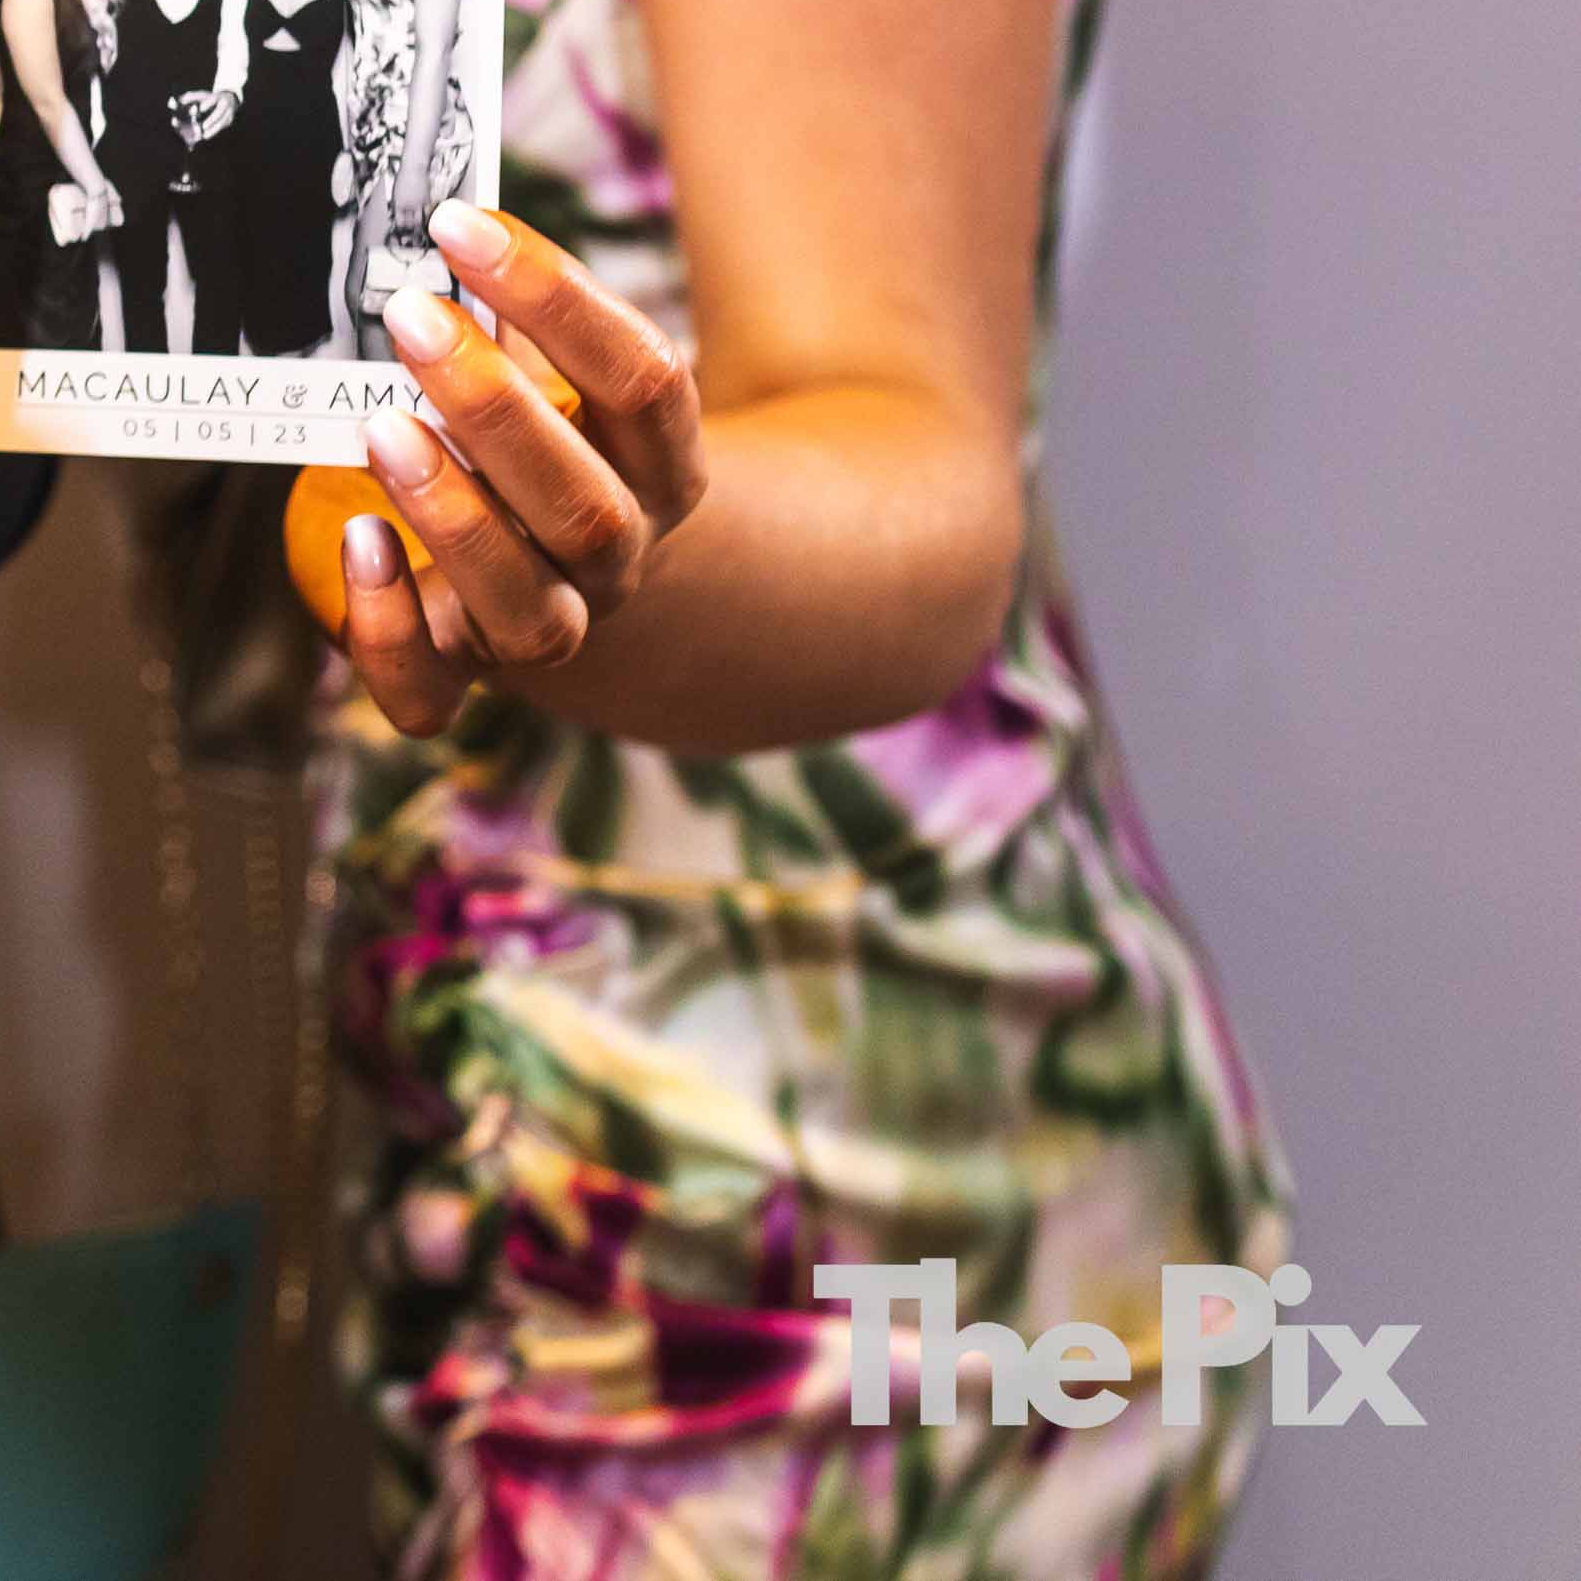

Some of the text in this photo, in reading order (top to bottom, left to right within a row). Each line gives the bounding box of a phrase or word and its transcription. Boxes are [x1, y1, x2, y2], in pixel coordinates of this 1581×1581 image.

[16, 370, 424, 412] MACAULAY & AMY
[122, 418, 158, 440] 05
[197, 421, 232, 442] 05
[273, 423, 307, 445] 23
